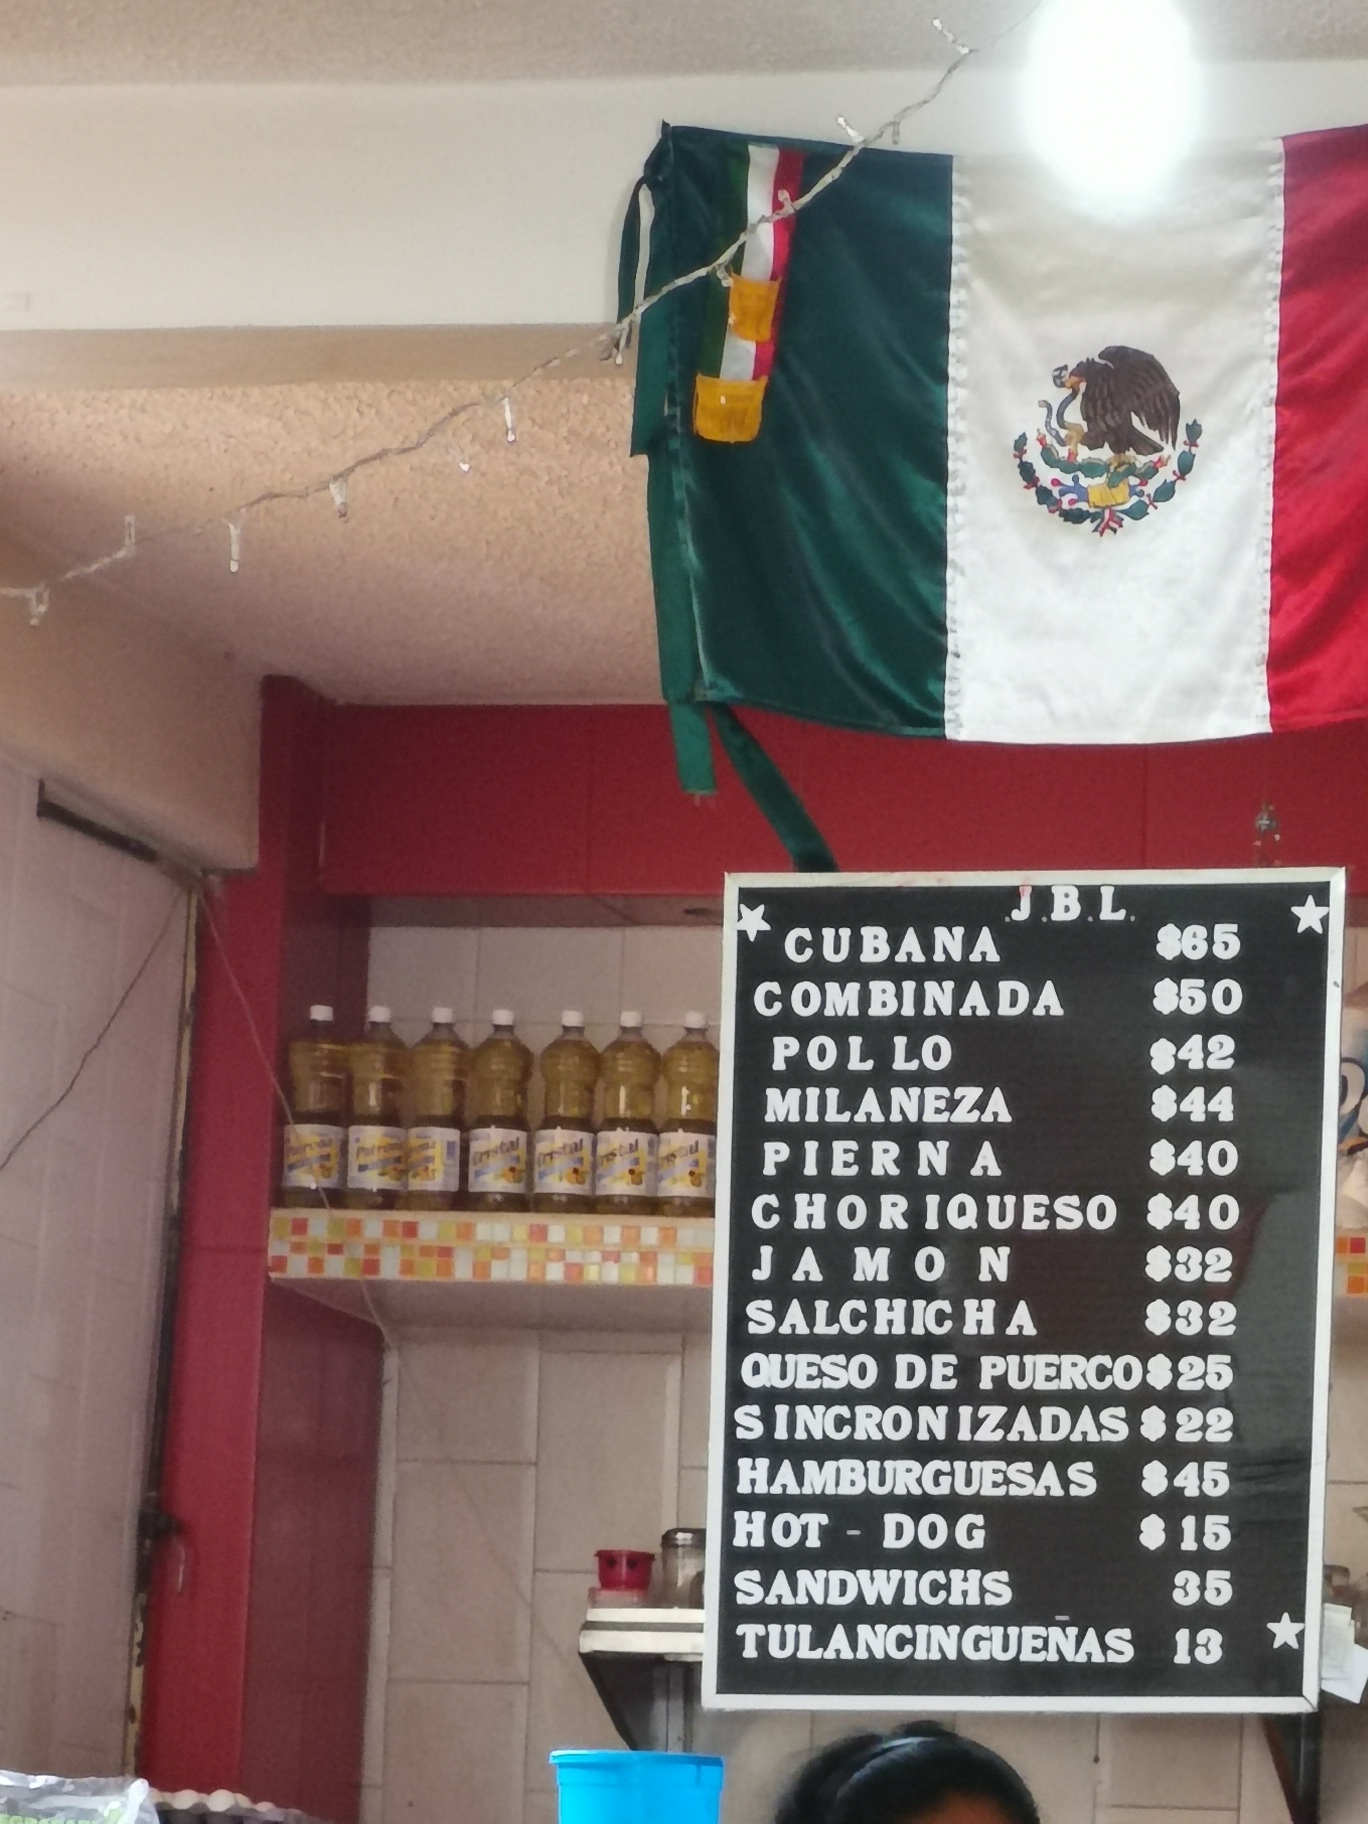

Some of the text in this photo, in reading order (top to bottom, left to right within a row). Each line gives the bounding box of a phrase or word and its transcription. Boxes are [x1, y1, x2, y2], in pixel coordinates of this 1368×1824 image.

[785, 923, 1240, 963] CUBANA $65
[754, 978, 1242, 1017] COMBINADA $50
[772, 1034, 1235, 1075] POLLO $42
[765, 1085, 1234, 1124] MILANEZA $44
[763, 1139, 1238, 1177] PIERNA $40
[752, 1193, 1239, 1231] CHORIQUESO $40
[752, 1245, 1232, 1282] JAMON $32
[746, 1298, 1236, 1337] SALCHICHA $32
[741, 1353, 1233, 1391] QUESO DE PUERCO $25
[734, 1404, 1233, 1443] SINCRONIZADAS $22
[737, 1458, 1230, 1497] HAMBURGUESAS $45
[733, 1511, 829, 1548] HOT
[883, 1513, 985, 1549] DOG
[1139, 1513, 1231, 1551] $15
[734, 1569, 1232, 1607] SANDWICHS 35
[736, 1616, 1222, 1664] TULANCINGUEÑAS 13
